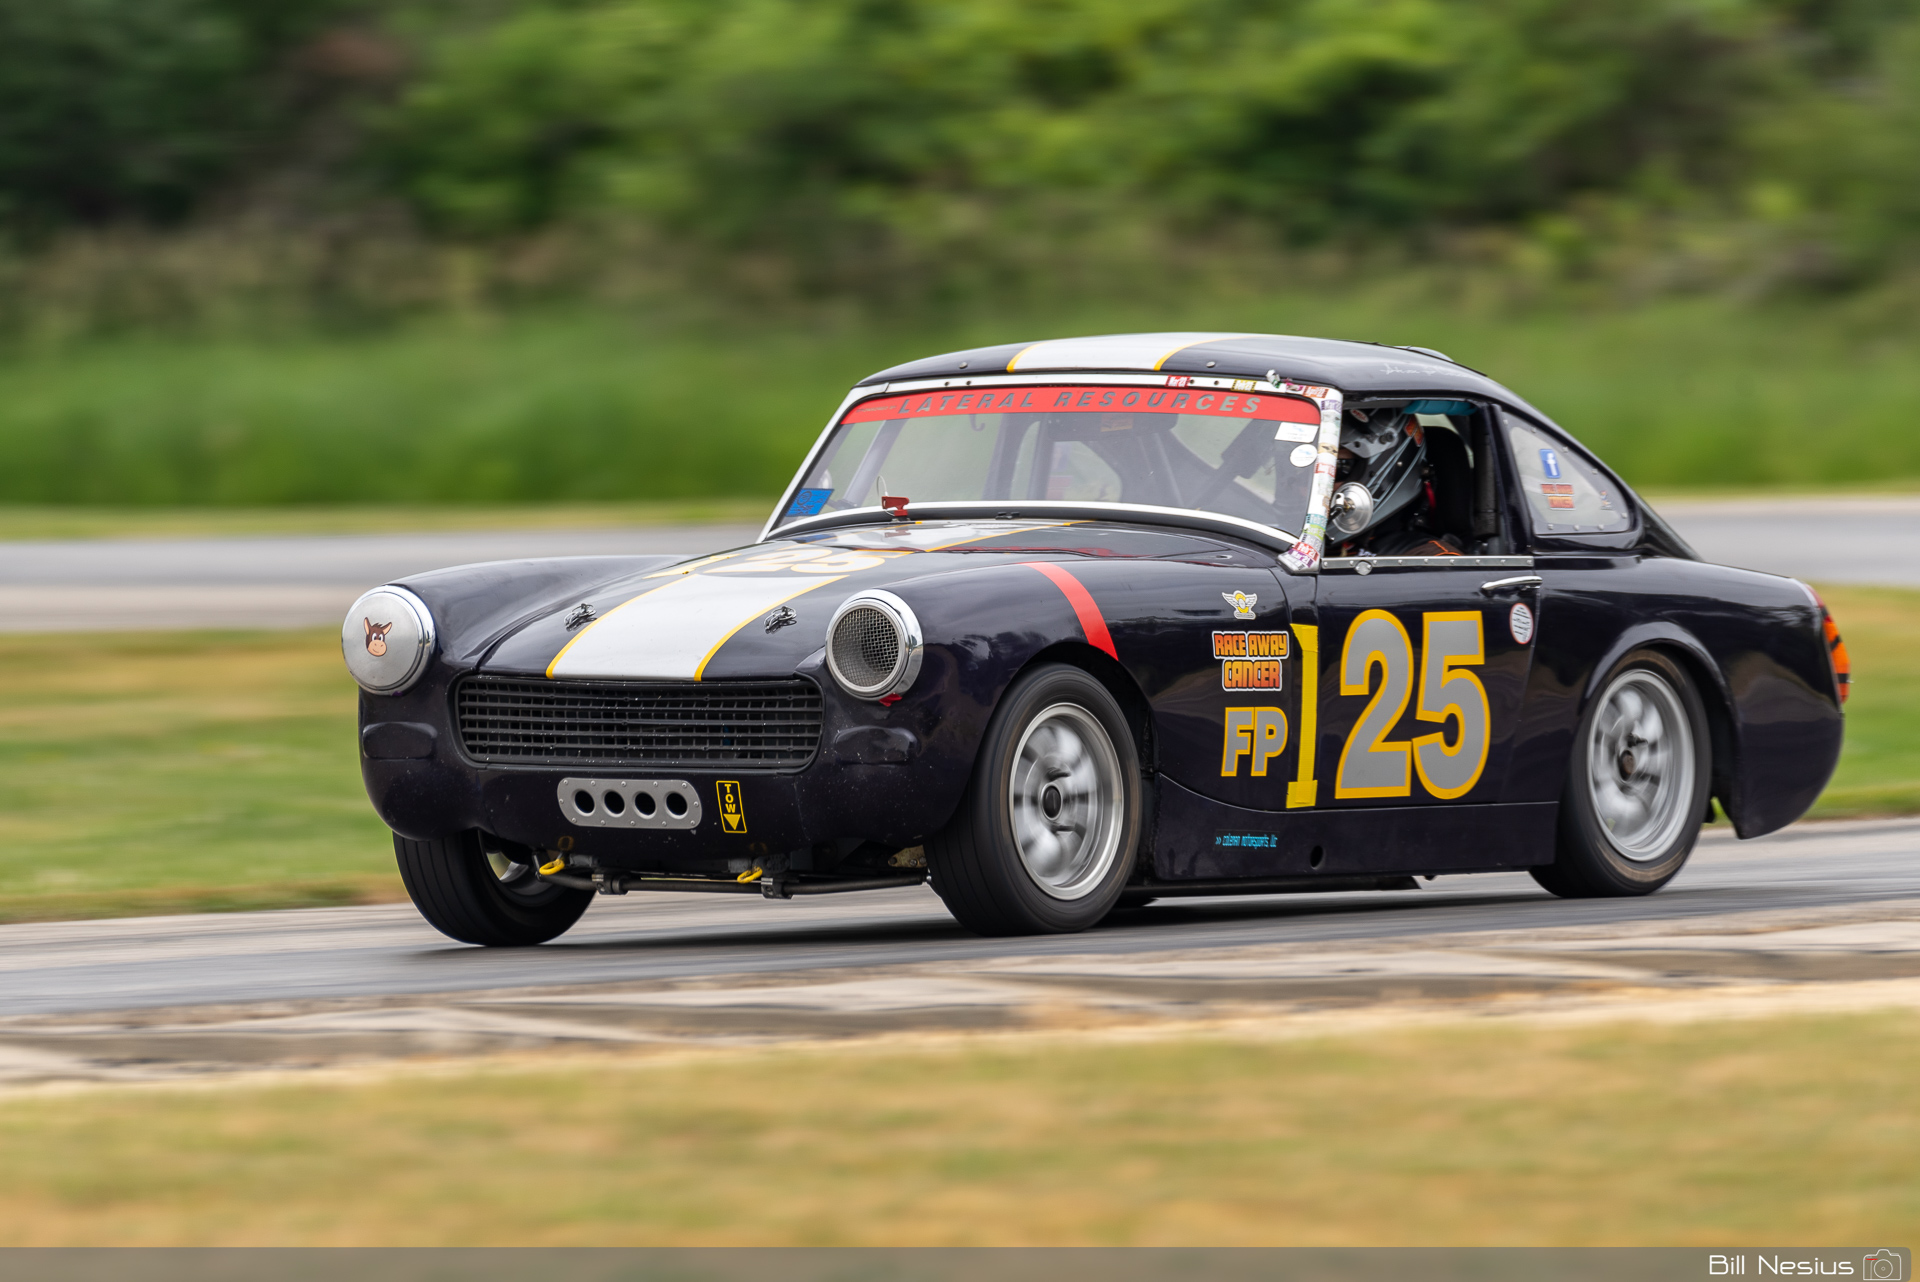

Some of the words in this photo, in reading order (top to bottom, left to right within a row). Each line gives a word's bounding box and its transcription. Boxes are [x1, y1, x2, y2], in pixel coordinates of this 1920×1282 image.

[898, 392, 1033, 414] LATERAL
[1053, 391, 1261, 413] RESOURCES
[1213, 633, 1247, 656] RACE
[1248, 633, 1288, 656] AWAY
[1223, 661, 1280, 689] CANCER
[1220, 706, 1289, 777] FP
[724, 783, 736, 814] TOW
